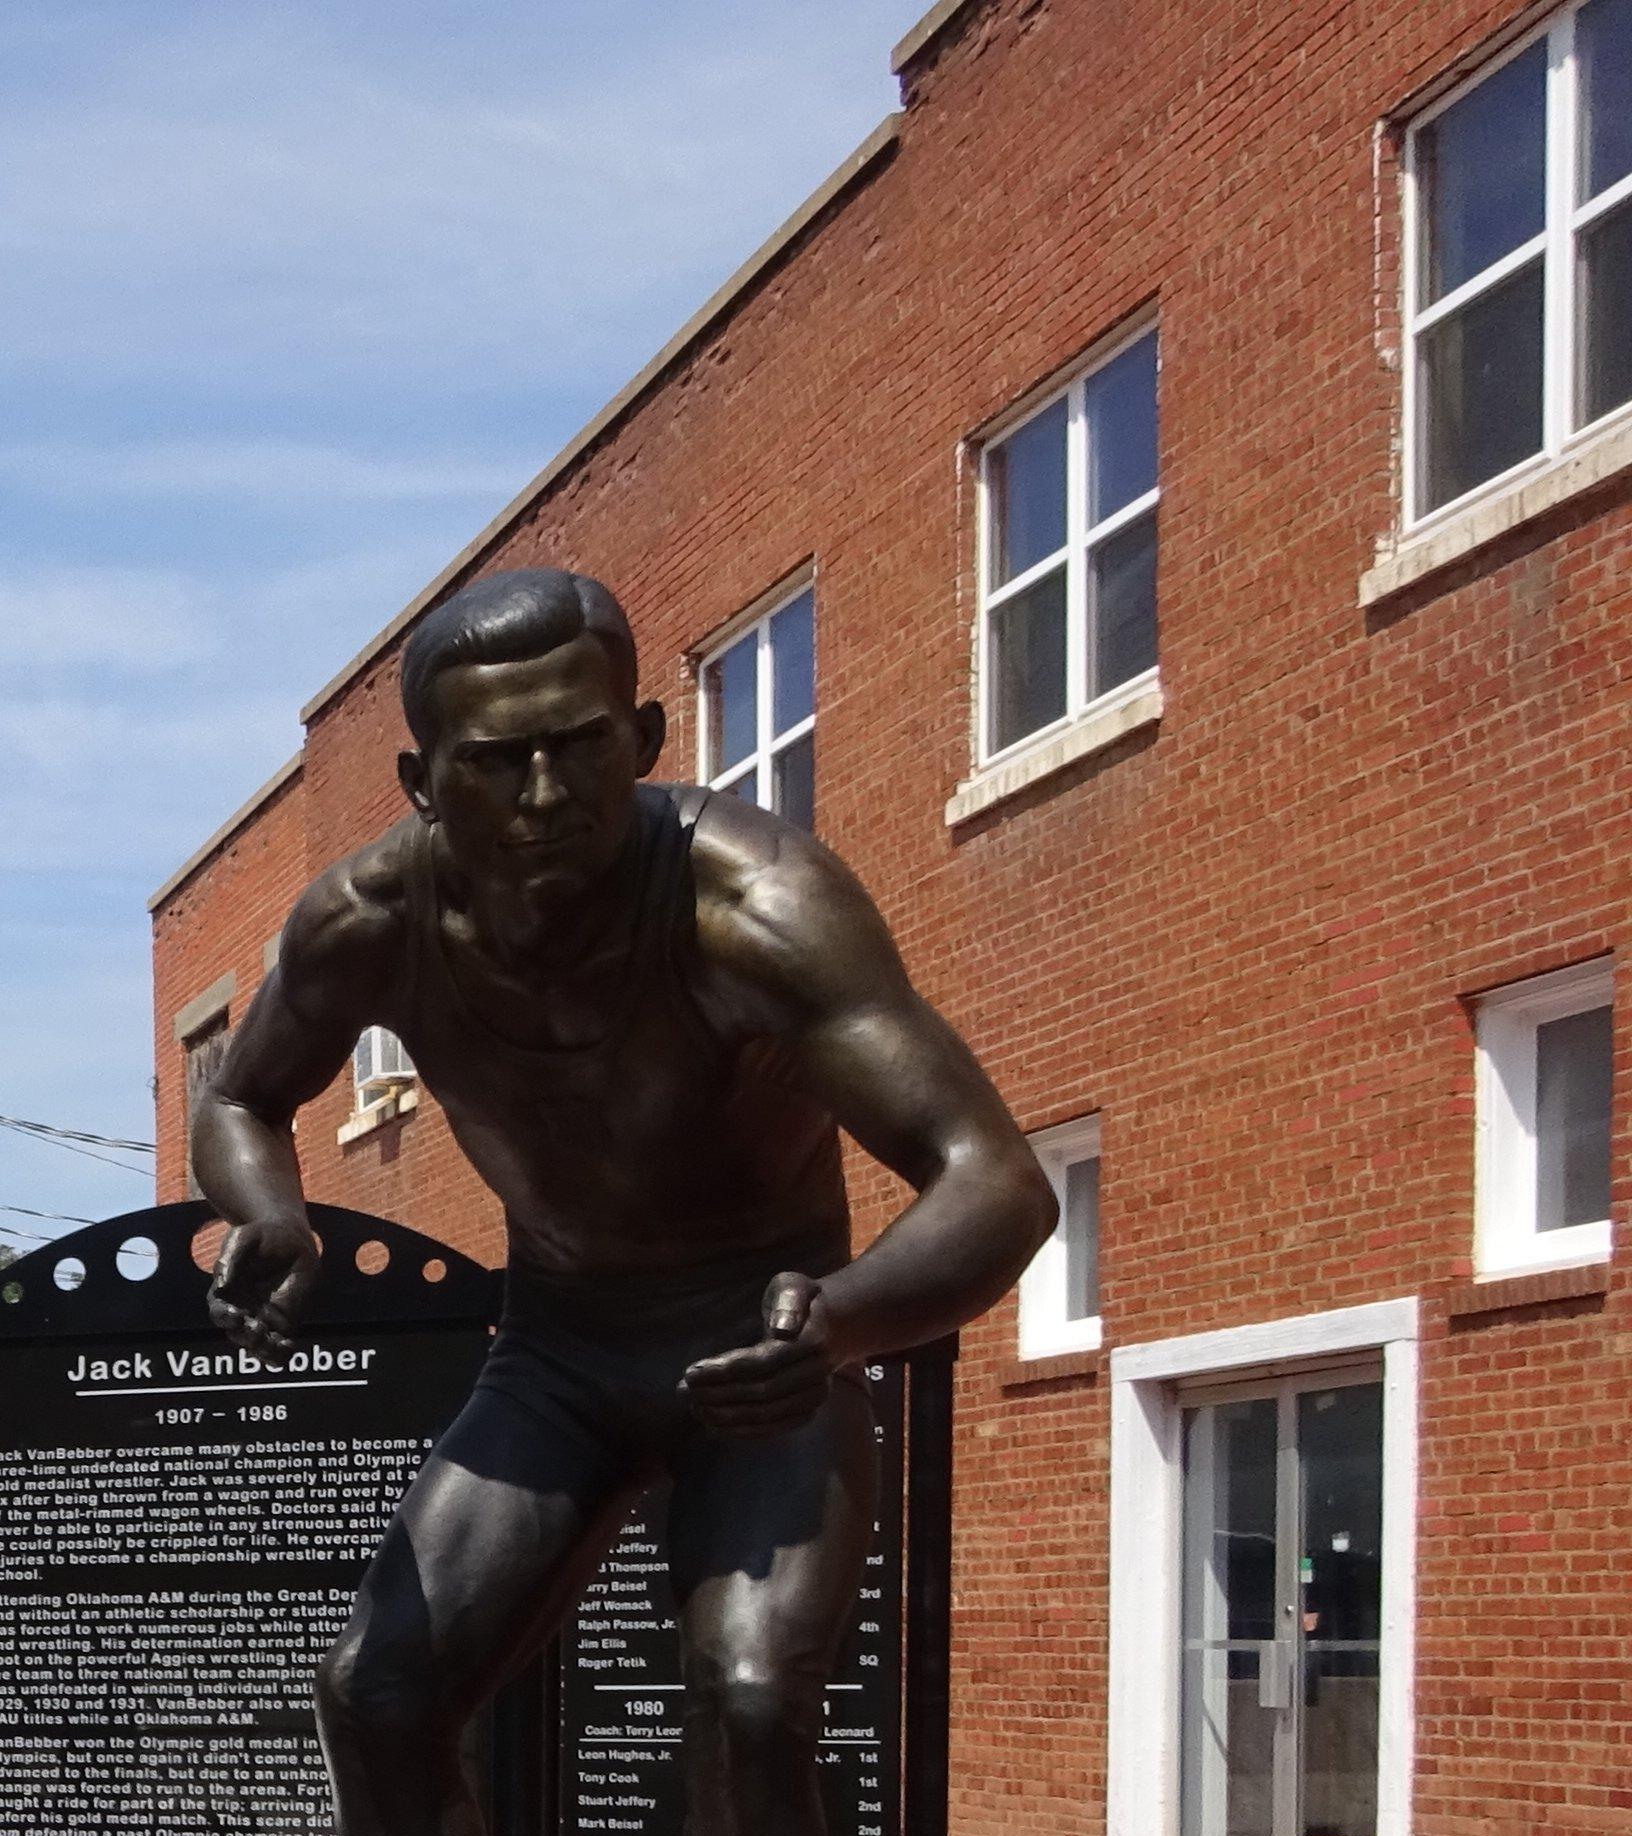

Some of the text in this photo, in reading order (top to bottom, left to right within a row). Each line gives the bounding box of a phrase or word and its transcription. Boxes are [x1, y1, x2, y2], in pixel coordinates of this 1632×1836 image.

[67, 1352, 152, 1382] Jack
[155, 1407, 205, 1425] 1907
[236, 1404, 288, 1422] 1986
[26, 1447, 112, 1461] VanBebber
[116, 1445, 194, 1458] overcame
[198, 1444, 242, 1457] many
[245, 1440, 326, 1454] obstacles
[330, 1439, 347, 1451] to
[352, 1438, 418, 1451] become
[422, 1438, 433, 1449] a
[577, 1600, 653, 1612] Jeff Womack
[577, 1656, 647, 1671] Roger Tetik
[624, 1700, 665, 1716] 1980
[584, 1724, 623, 1736] Coach:
[625, 1724, 655, 1738] Terry
[577, 1749, 673, 1763] Leon Hughes, Jr.
[577, 1771, 640, 1785] Tony Cook
[577, 1794, 656, 1810] Stuart Jeffery
